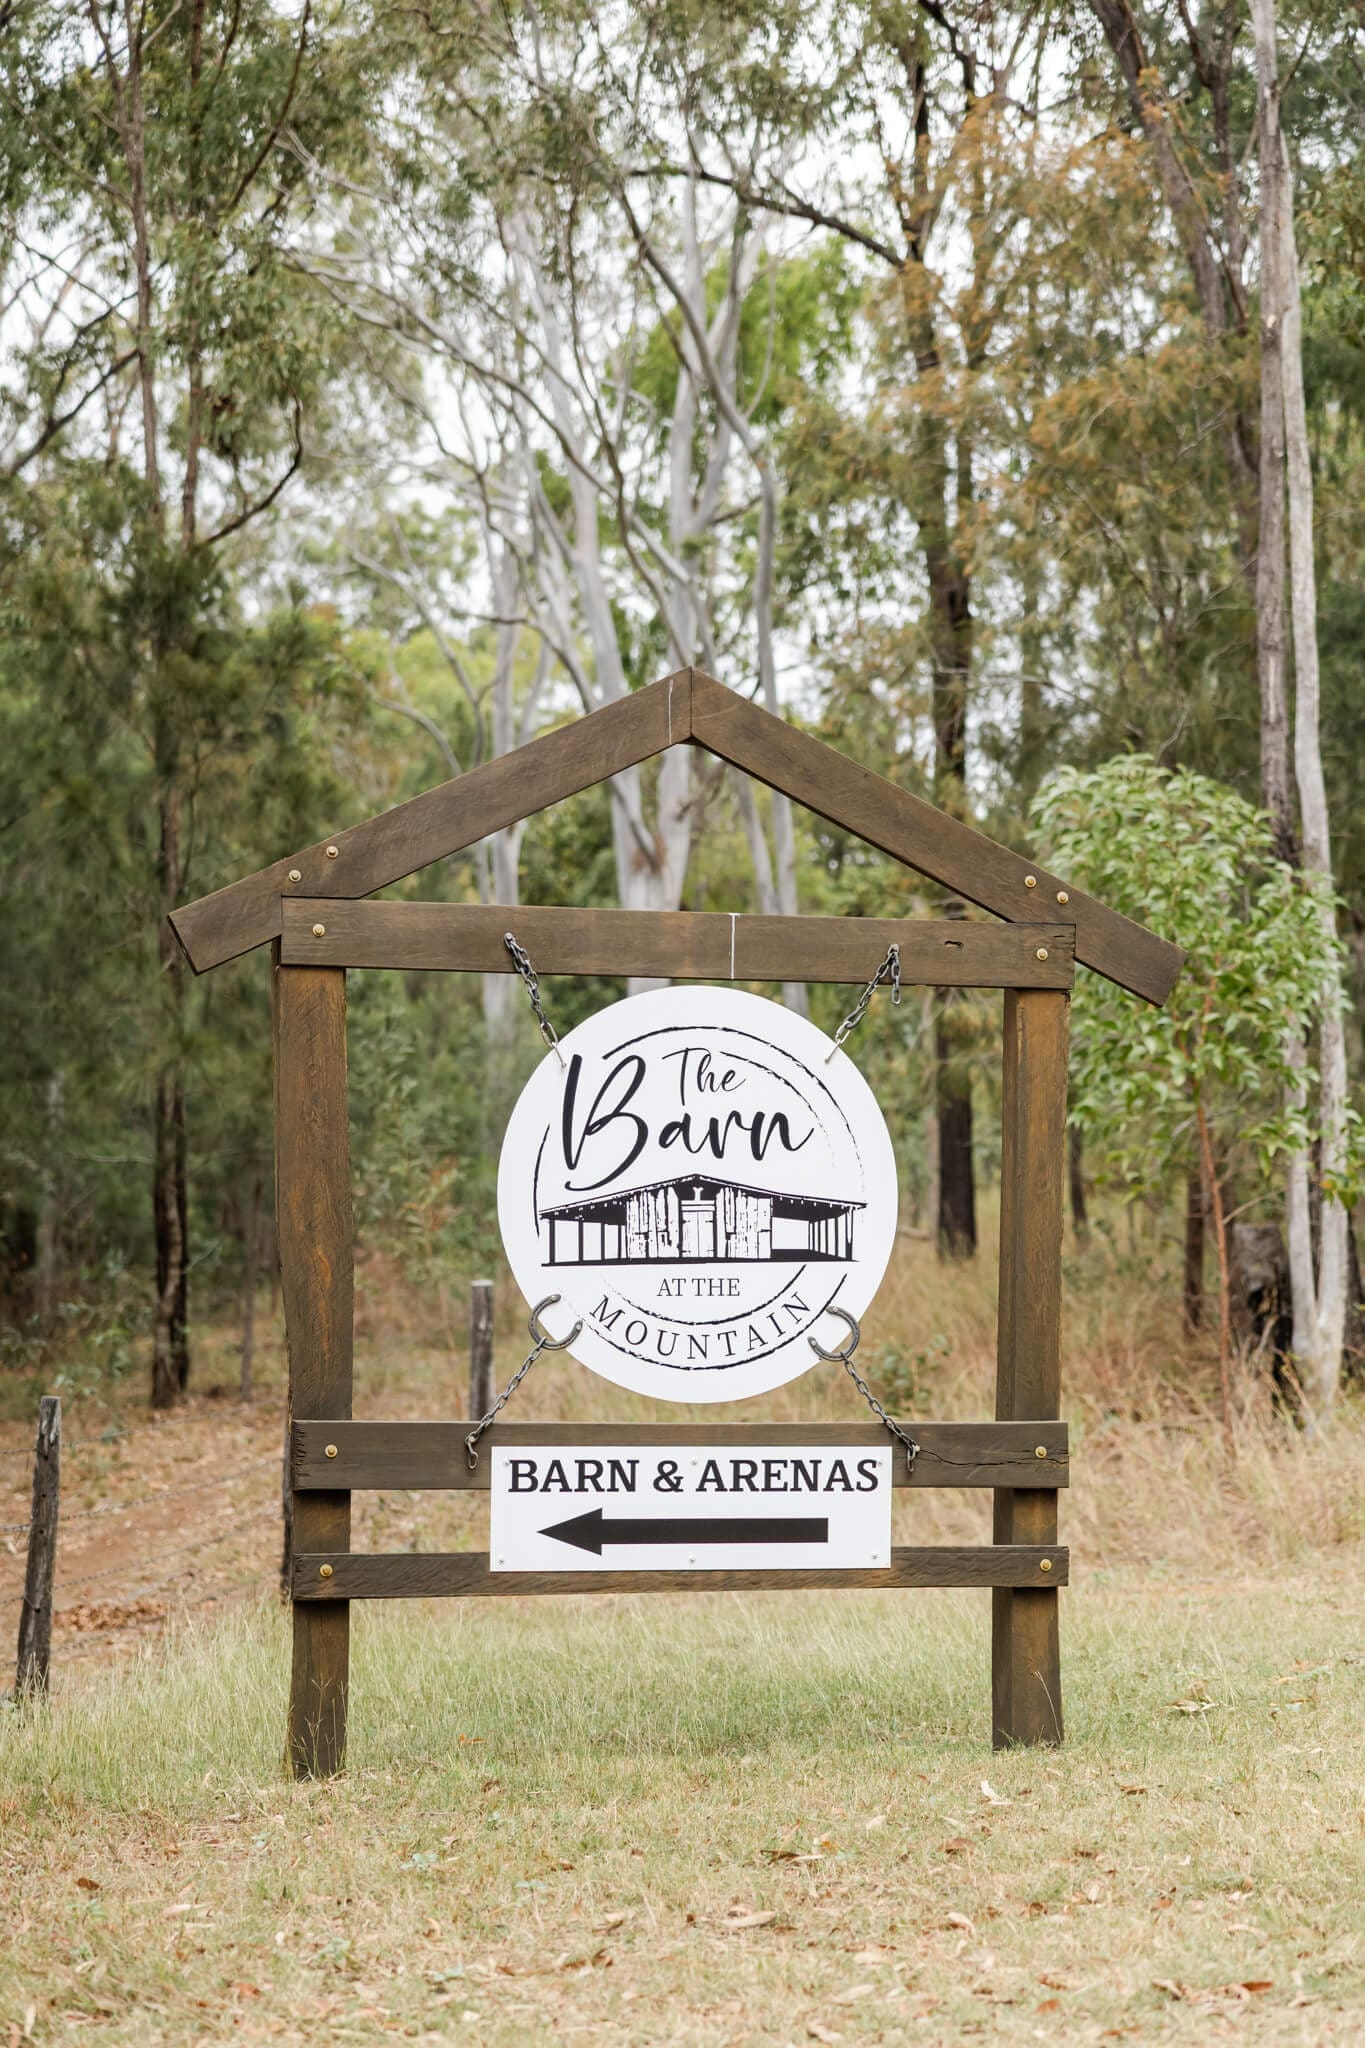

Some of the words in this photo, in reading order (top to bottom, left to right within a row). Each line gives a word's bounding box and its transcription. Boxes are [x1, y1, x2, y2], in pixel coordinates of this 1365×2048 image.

[661, 1046, 746, 1106] The
[562, 1053, 814, 1192] Barn
[657, 1278, 687, 1297] AT
[693, 1278, 741, 1297] THE
[588, 1291, 812, 1360] MOUNTAIN
[508, 1459, 640, 1493] BARN
[652, 1459, 684, 1493] &
[695, 1459, 880, 1493] ARENAS
